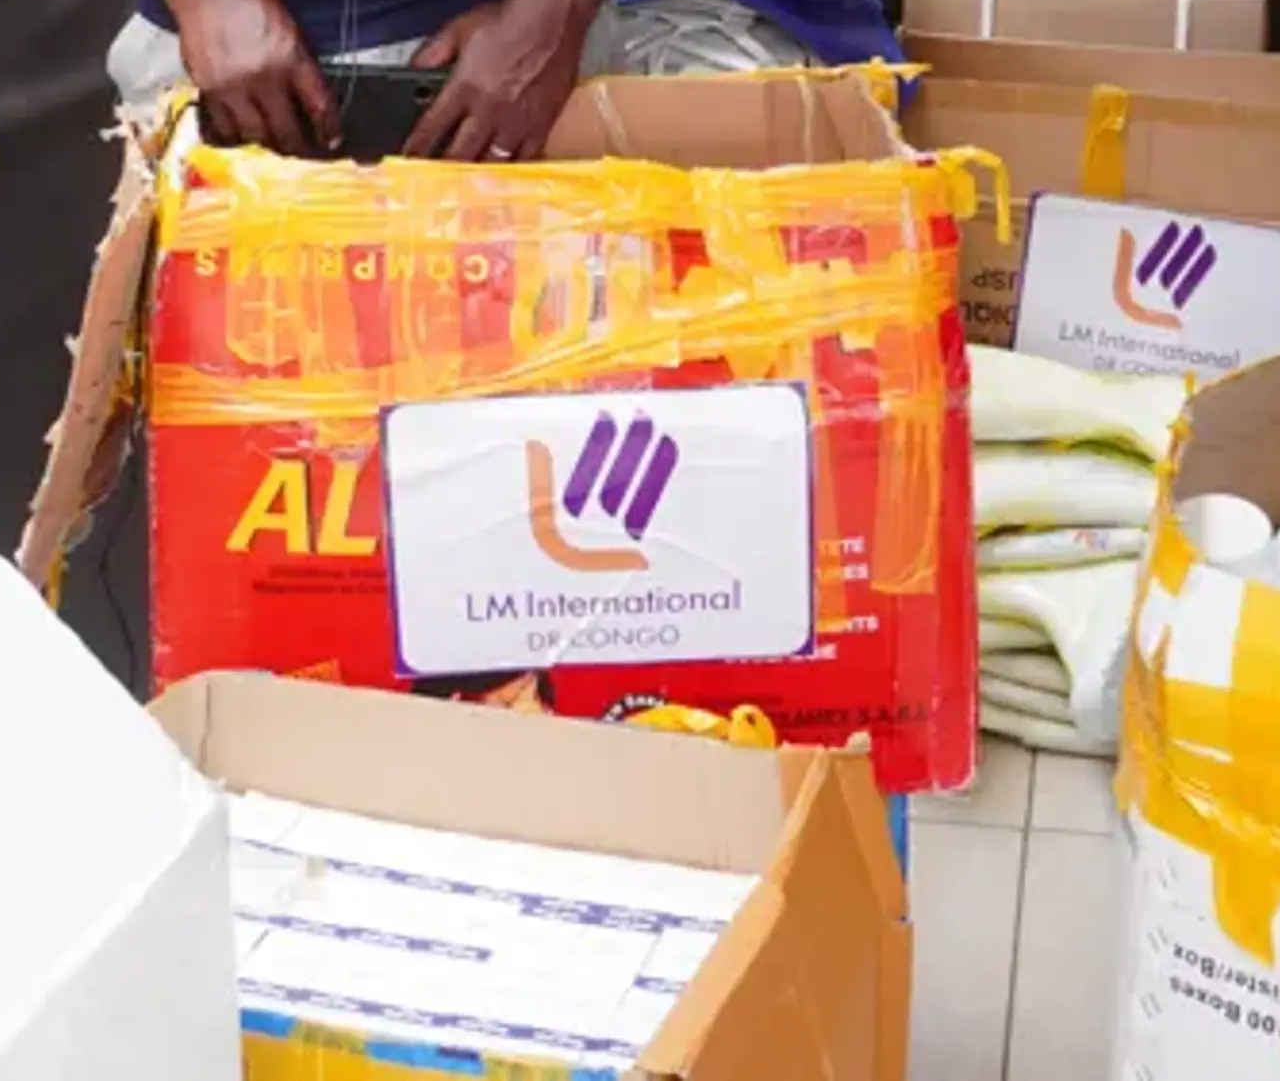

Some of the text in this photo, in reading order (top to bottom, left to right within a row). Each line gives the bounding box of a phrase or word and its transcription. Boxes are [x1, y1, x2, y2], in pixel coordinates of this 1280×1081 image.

[1057, 320, 1242, 369] LM International
[465, 578, 742, 622] LM International
[527, 623, 681, 653] DR CONGO
[1168, 975, 1242, 1025] Boxes
